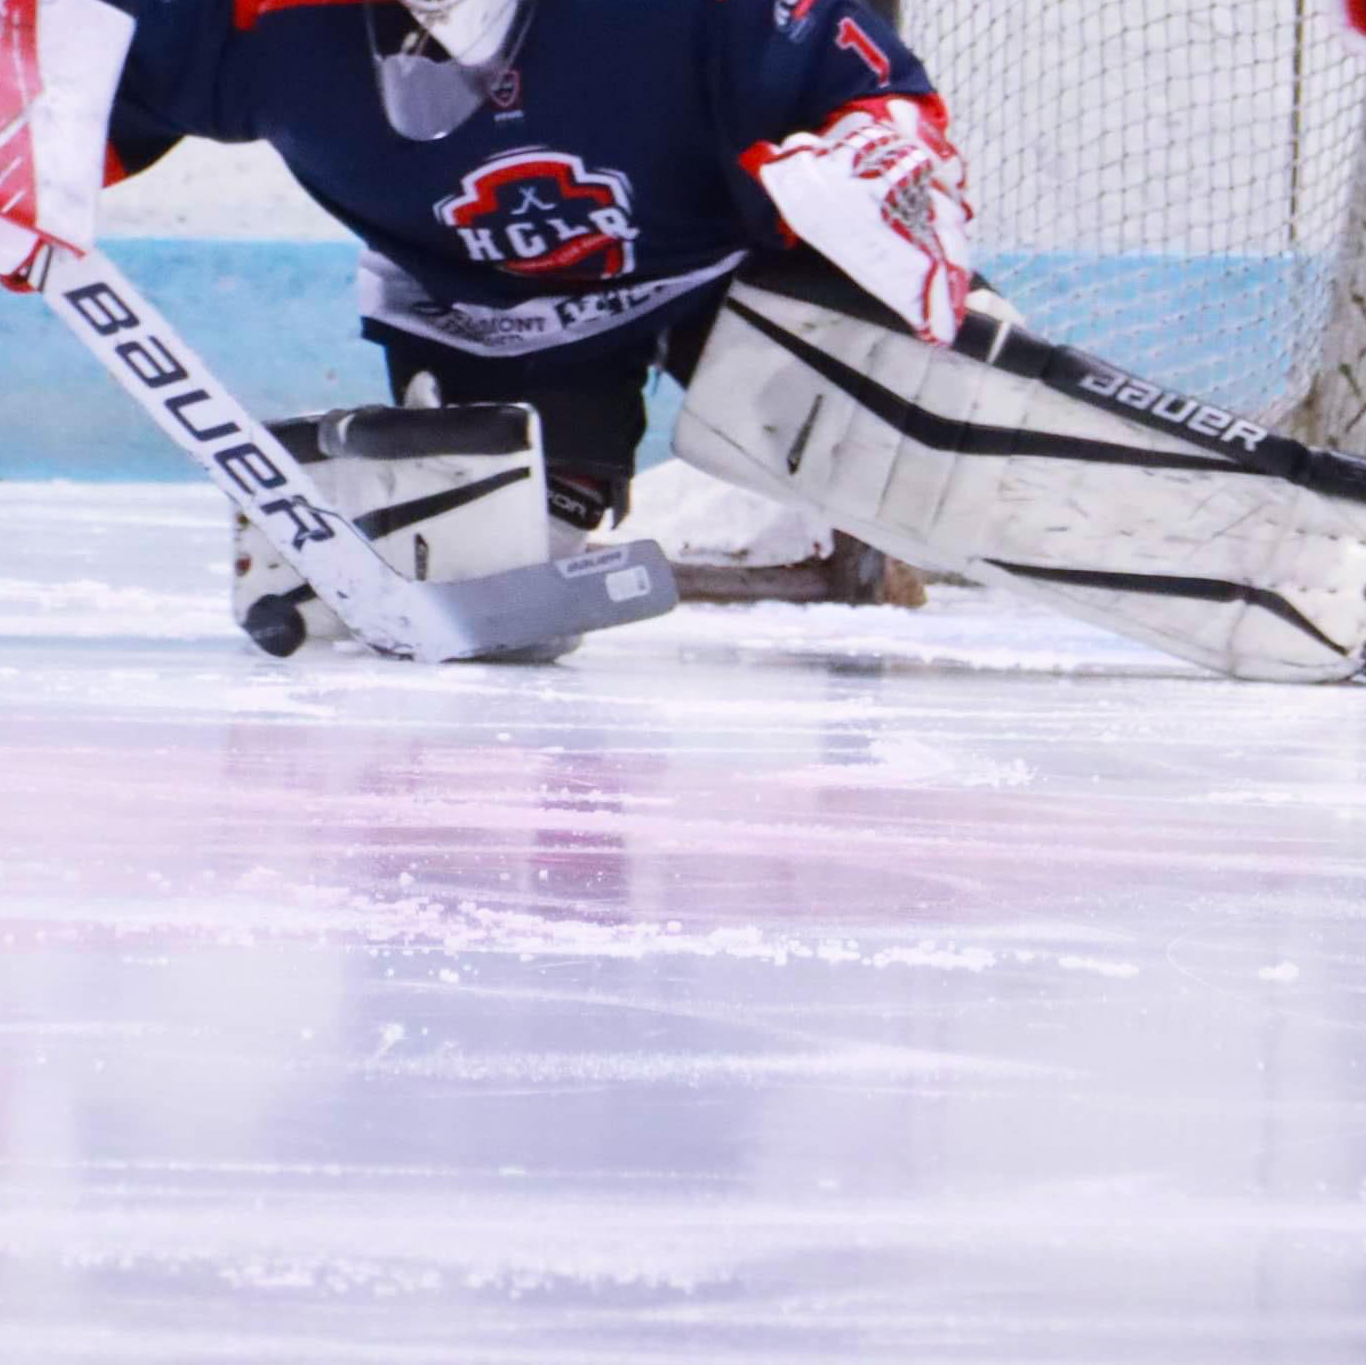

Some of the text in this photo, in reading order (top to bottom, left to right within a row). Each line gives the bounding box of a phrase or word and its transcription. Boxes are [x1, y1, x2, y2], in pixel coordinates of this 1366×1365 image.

[835, 16, 892, 89] 1
[63, 282, 336, 552] BAUER
[1079, 370, 1269, 452] BAUER
